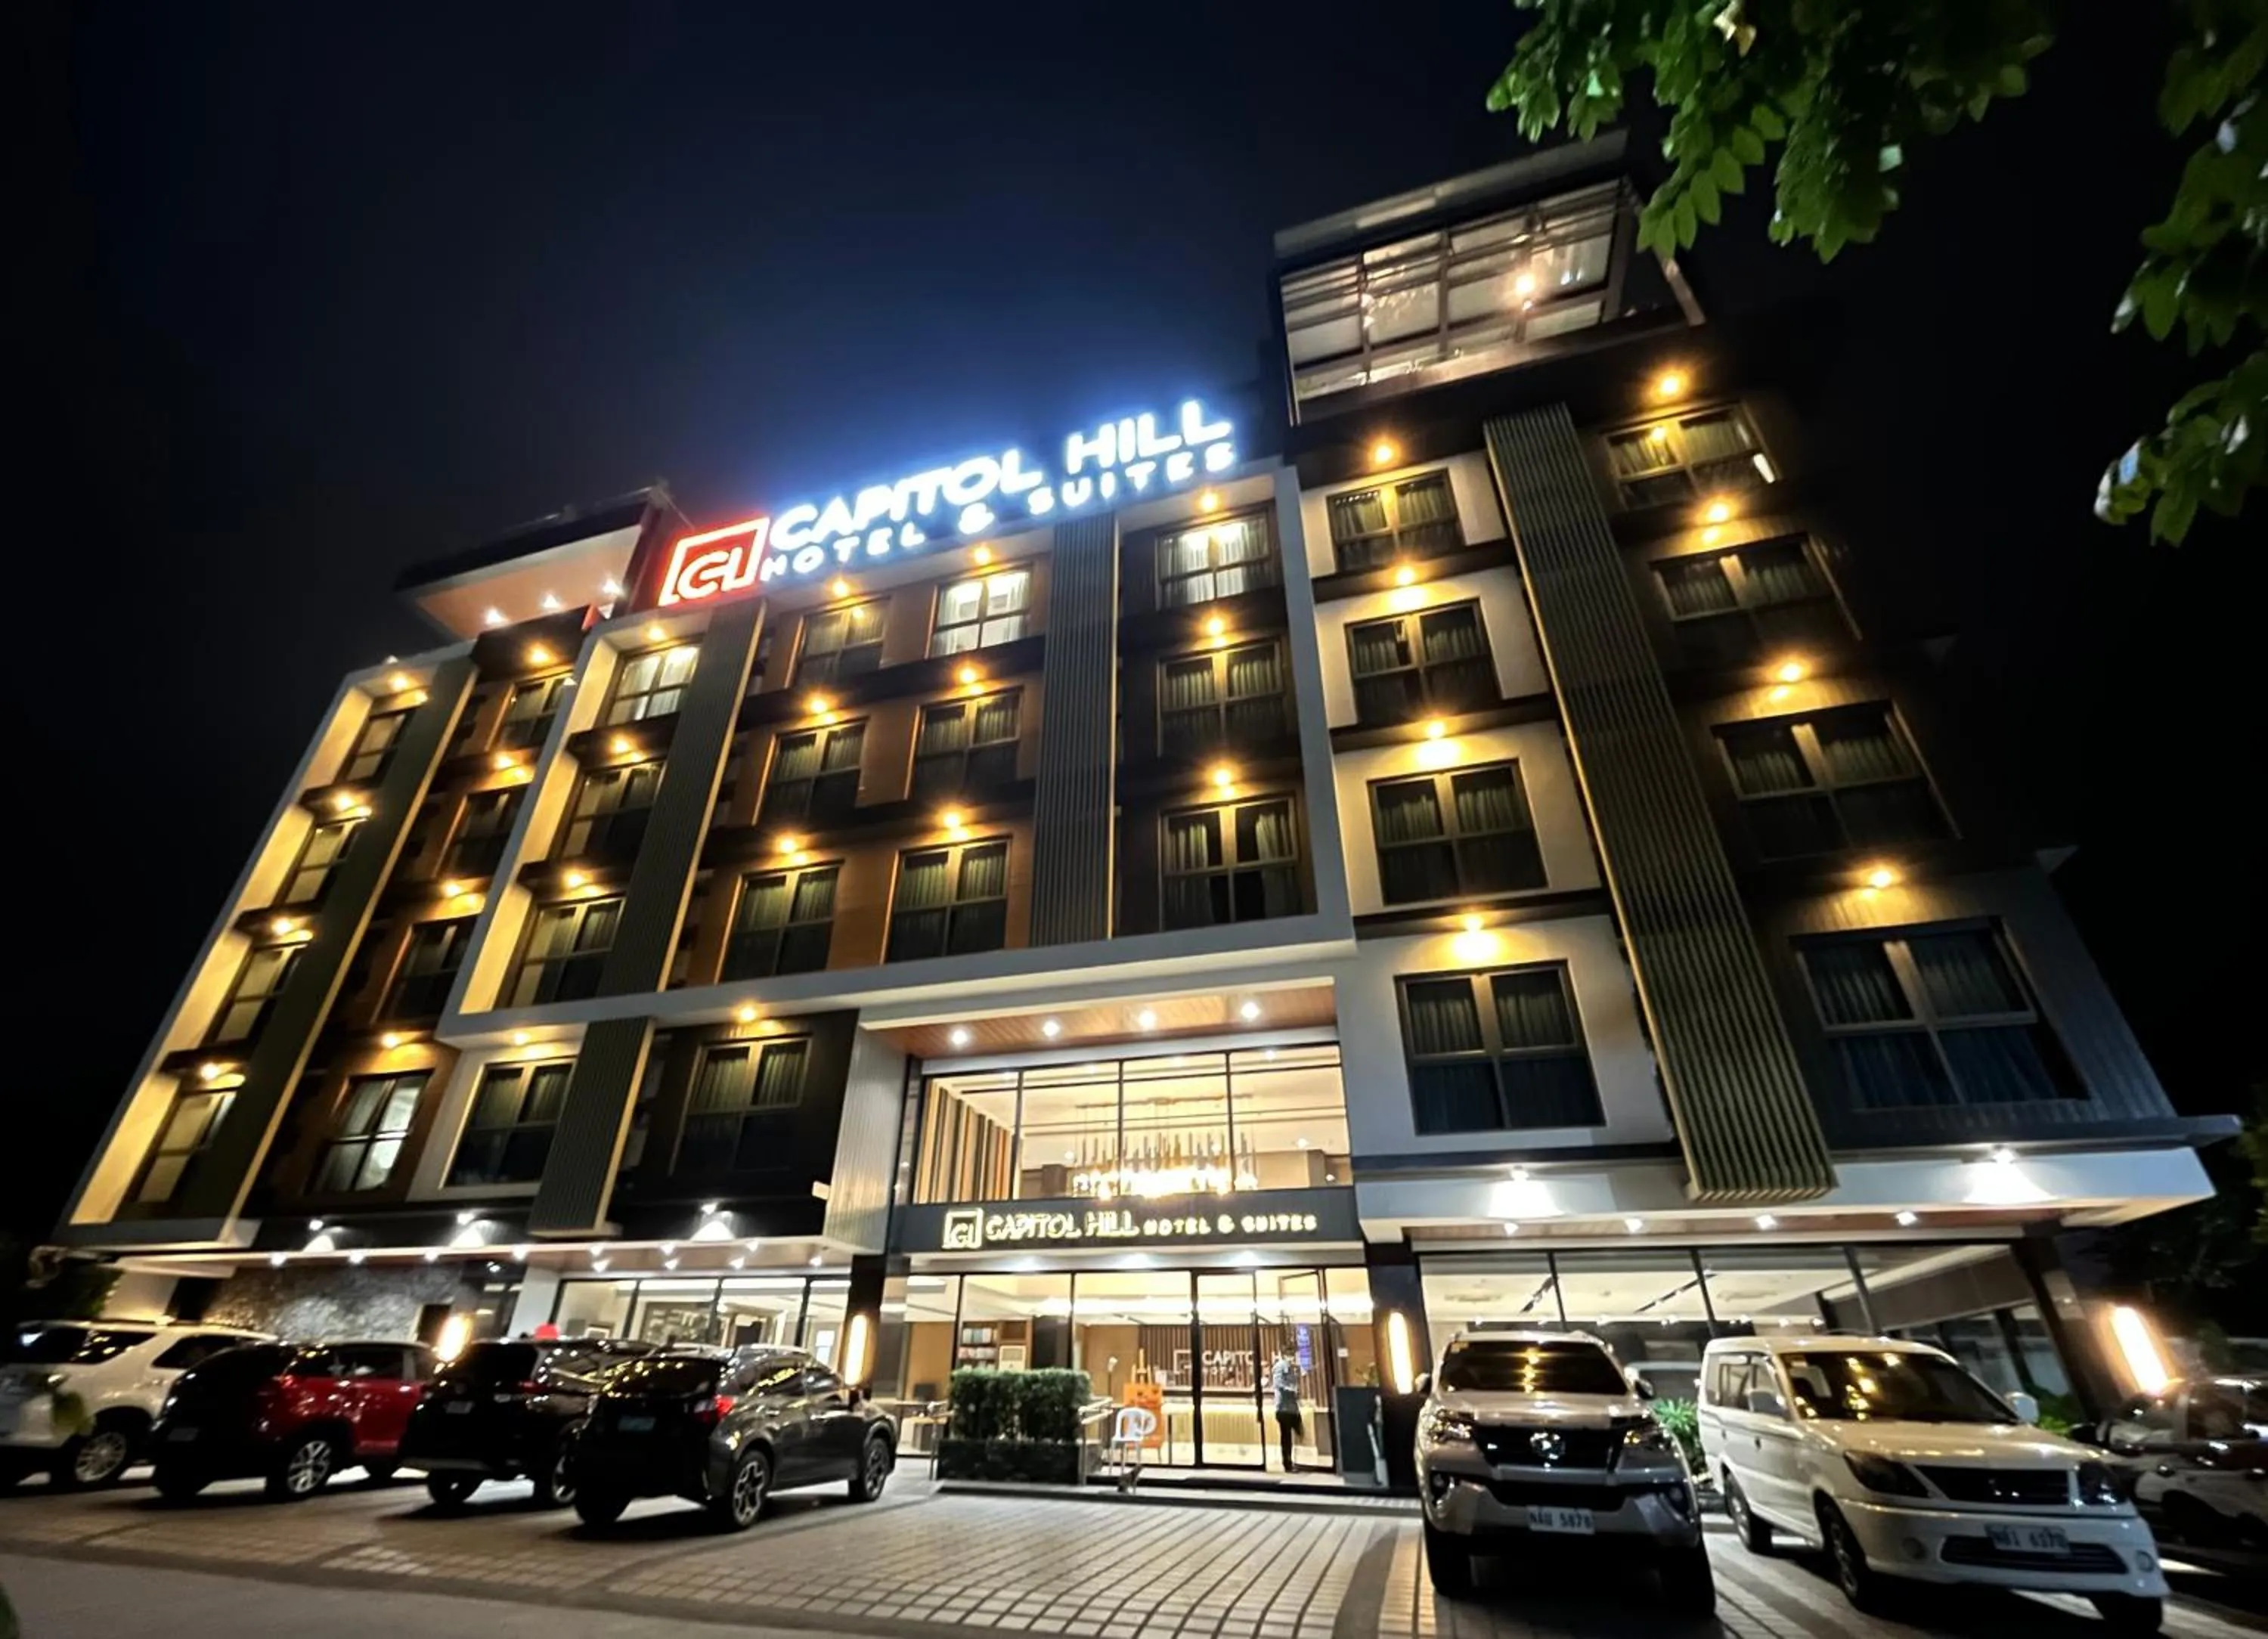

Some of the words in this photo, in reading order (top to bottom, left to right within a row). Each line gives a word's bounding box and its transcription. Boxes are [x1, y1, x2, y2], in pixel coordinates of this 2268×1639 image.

[759, 522, 925, 581] HOTEL
[959, 502, 994, 534] &
[1027, 442, 1235, 516] SUITES
[770, 448, 1043, 551] CAPITOL
[1067, 400, 1232, 475] HILL
[985, 1213, 1083, 1241] CAPITOL
[1084, 1210, 1140, 1238] HILL
[1143, 1216, 1212, 1237] HOTEL
[1241, 1213, 1318, 1234] SUITES
[1202, 1349, 1255, 1366] CAPITO
